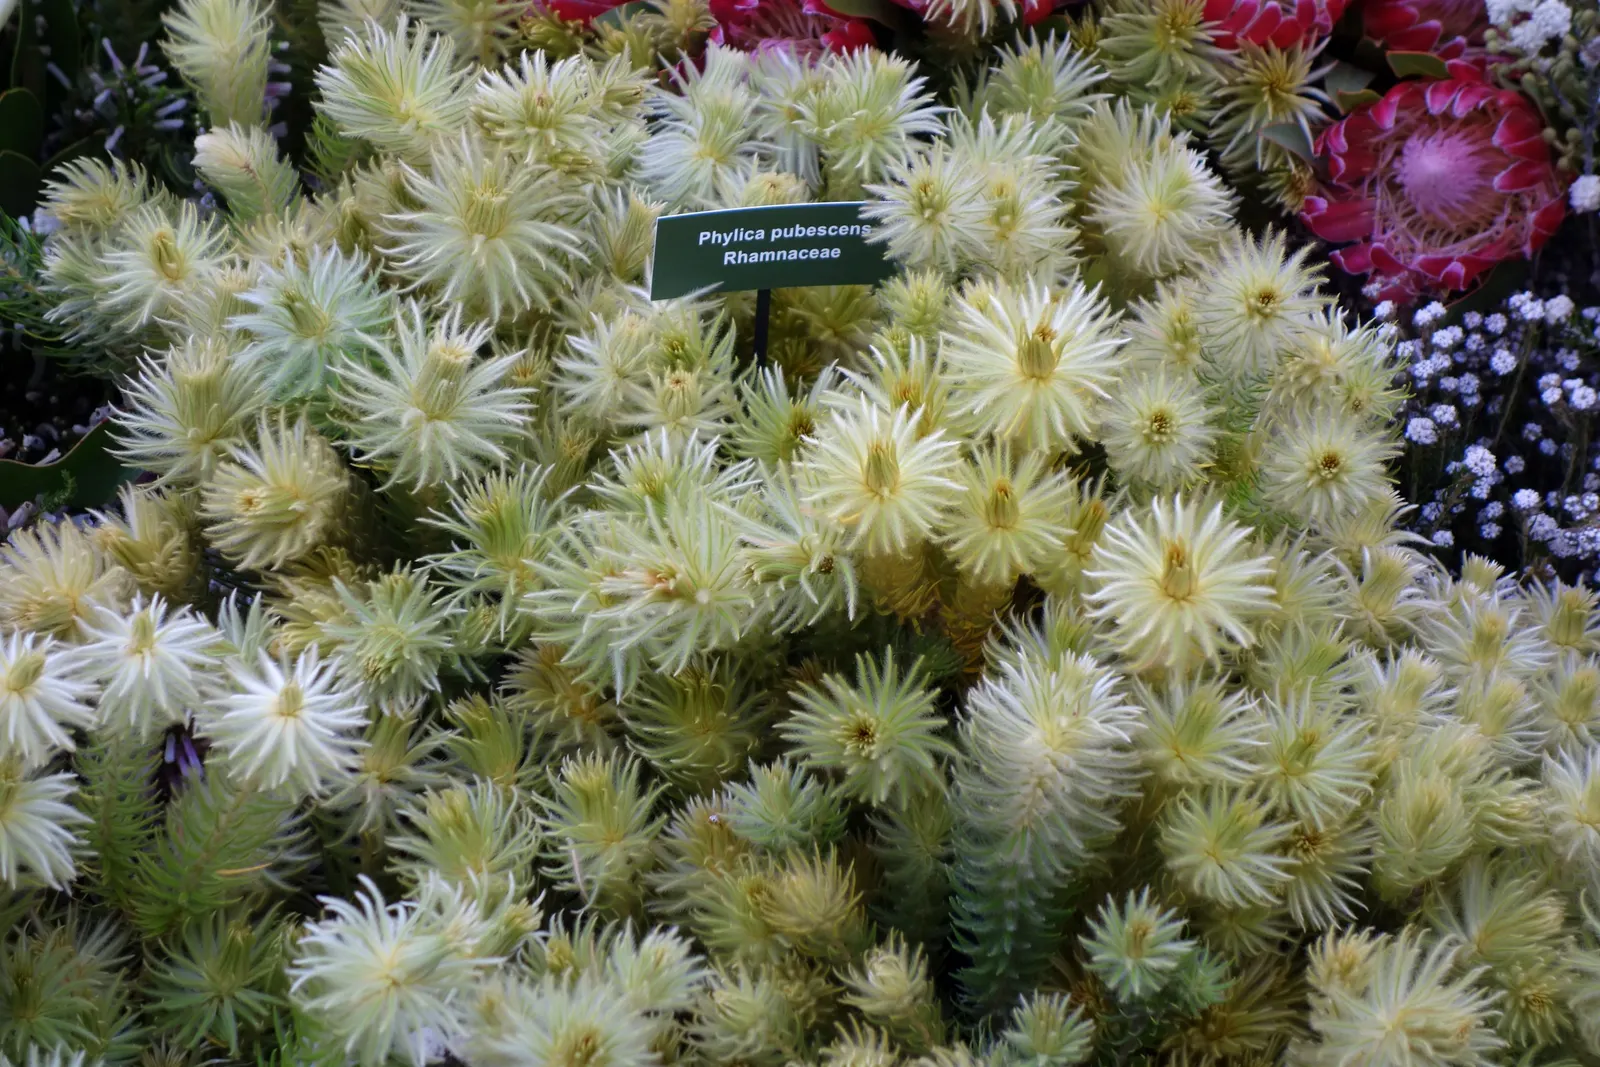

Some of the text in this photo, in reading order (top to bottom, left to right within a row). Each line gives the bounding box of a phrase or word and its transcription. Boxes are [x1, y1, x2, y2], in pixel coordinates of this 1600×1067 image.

[699, 224, 871, 246] Phylica pubescens
[723, 247, 841, 265] Rhamnaceae
